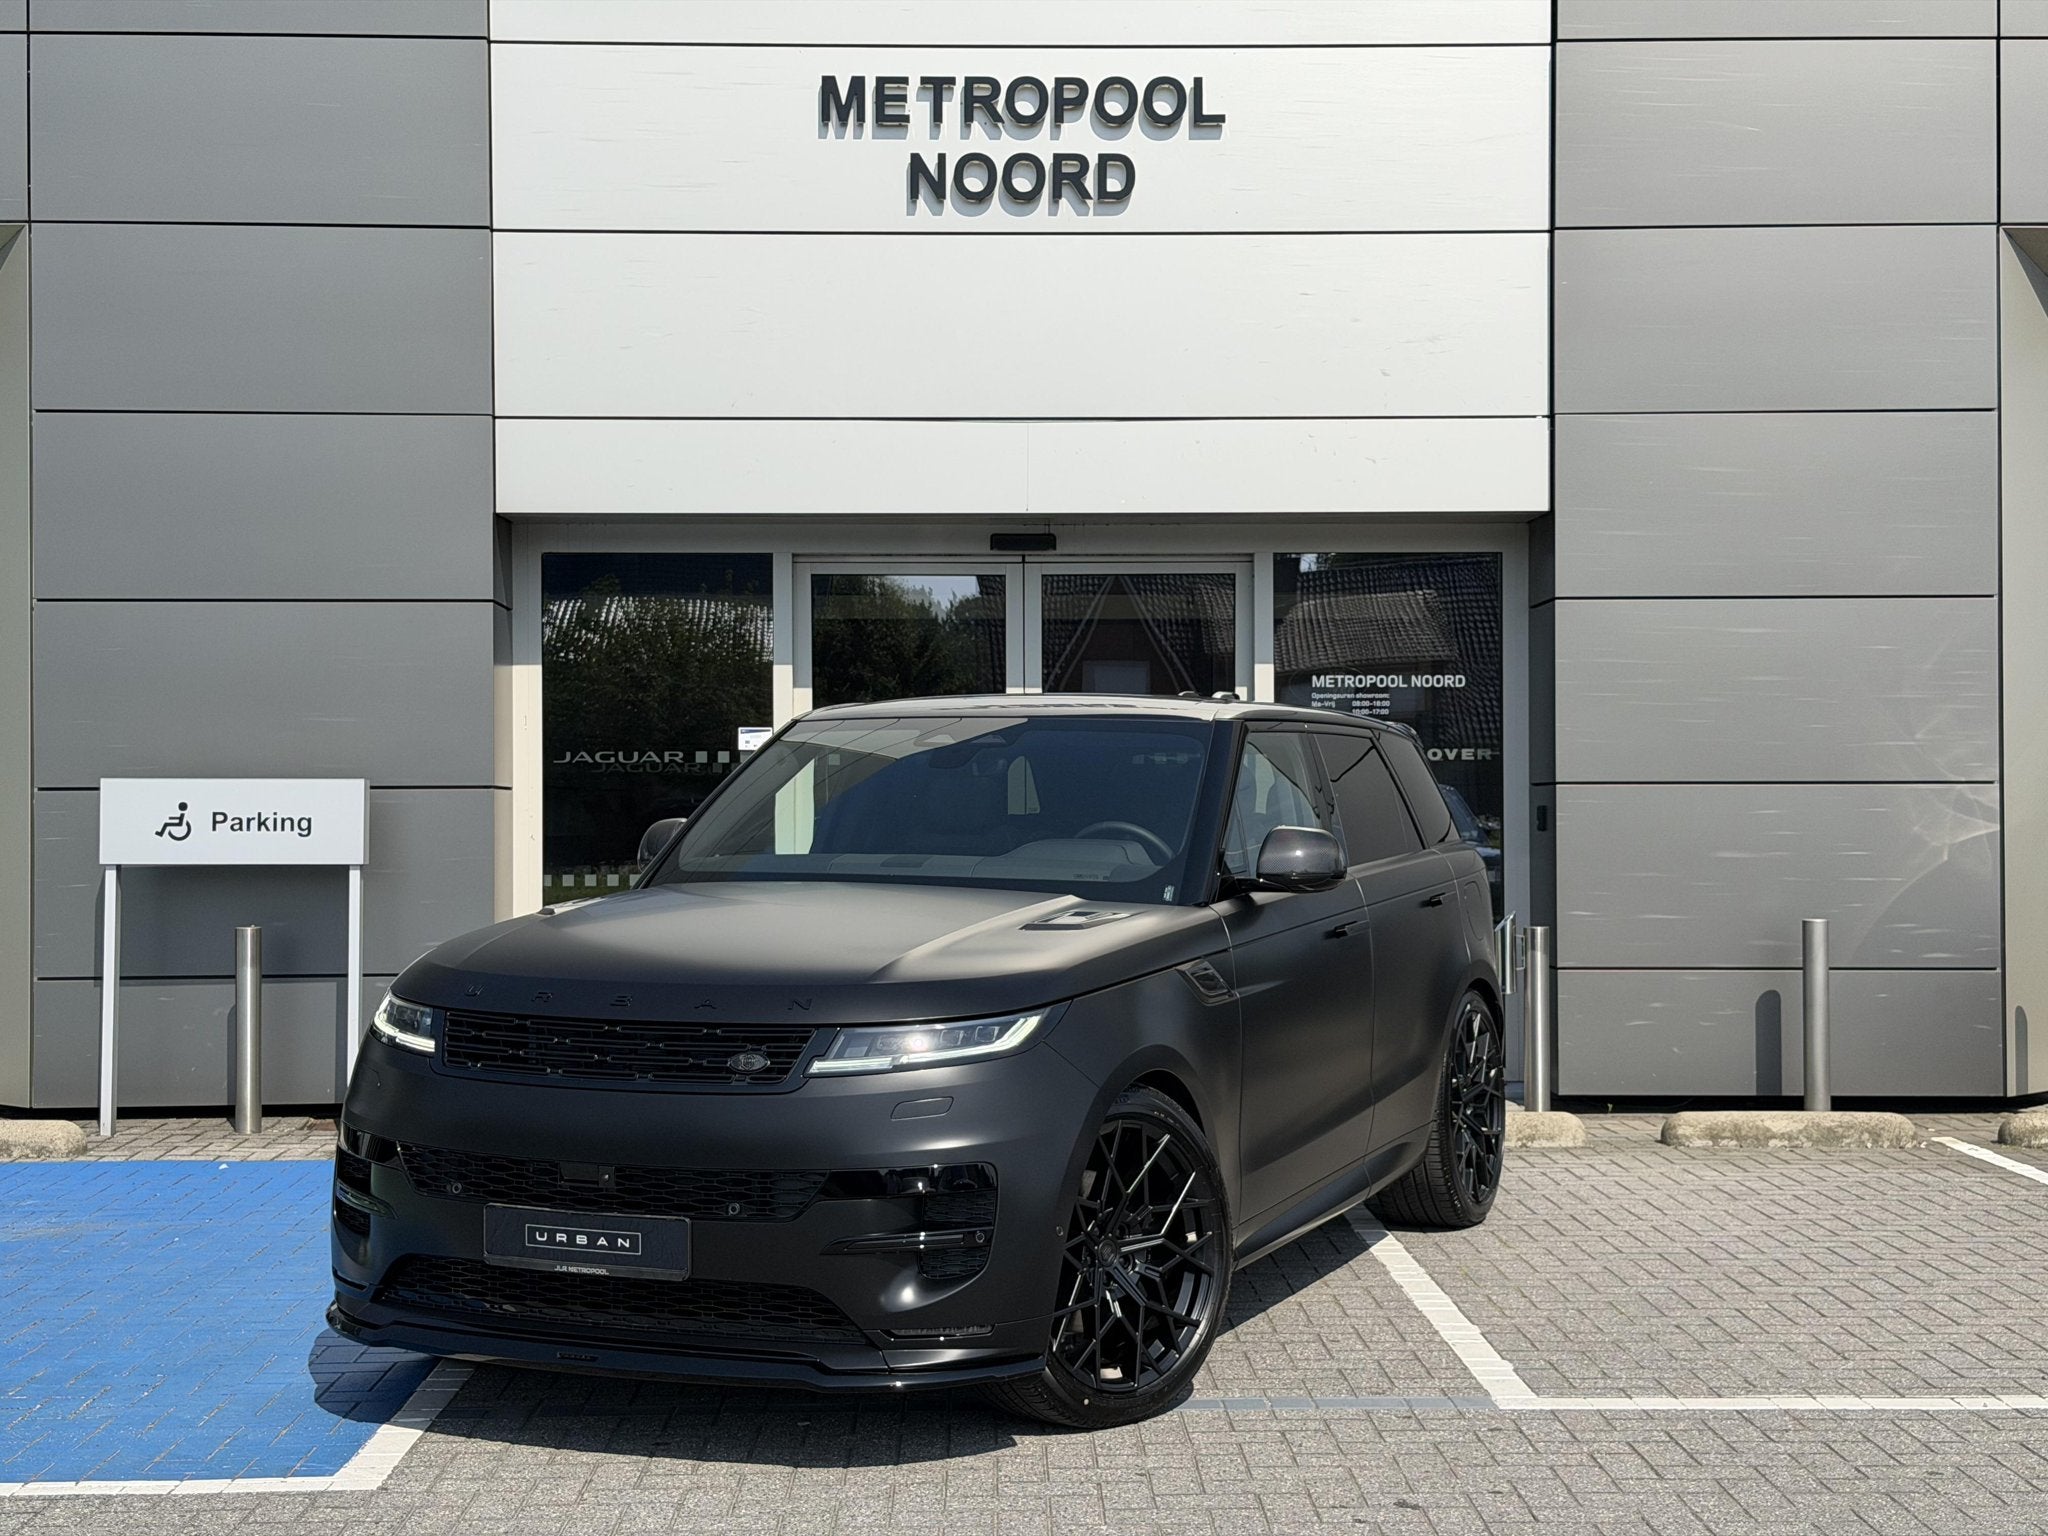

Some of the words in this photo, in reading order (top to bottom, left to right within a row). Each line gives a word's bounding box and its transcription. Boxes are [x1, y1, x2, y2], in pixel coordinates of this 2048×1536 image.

[821, 75, 1226, 125] METROPOOL
[910, 152, 1136, 202] NOORD
[1311, 674, 1408, 688] METROPOOL
[1411, 674, 1466, 688] NOORD
[1311, 692, 1355, 700] Openingsuren
[553, 750, 685, 764] JAGUAR
[1426, 747, 1492, 762] OVER
[211, 811, 312, 838] Parking
[463, 983, 813, 1011] URBAN
[535, 1231, 630, 1248] URBAN
[568, 1265, 610, 1276] METROPOOL
